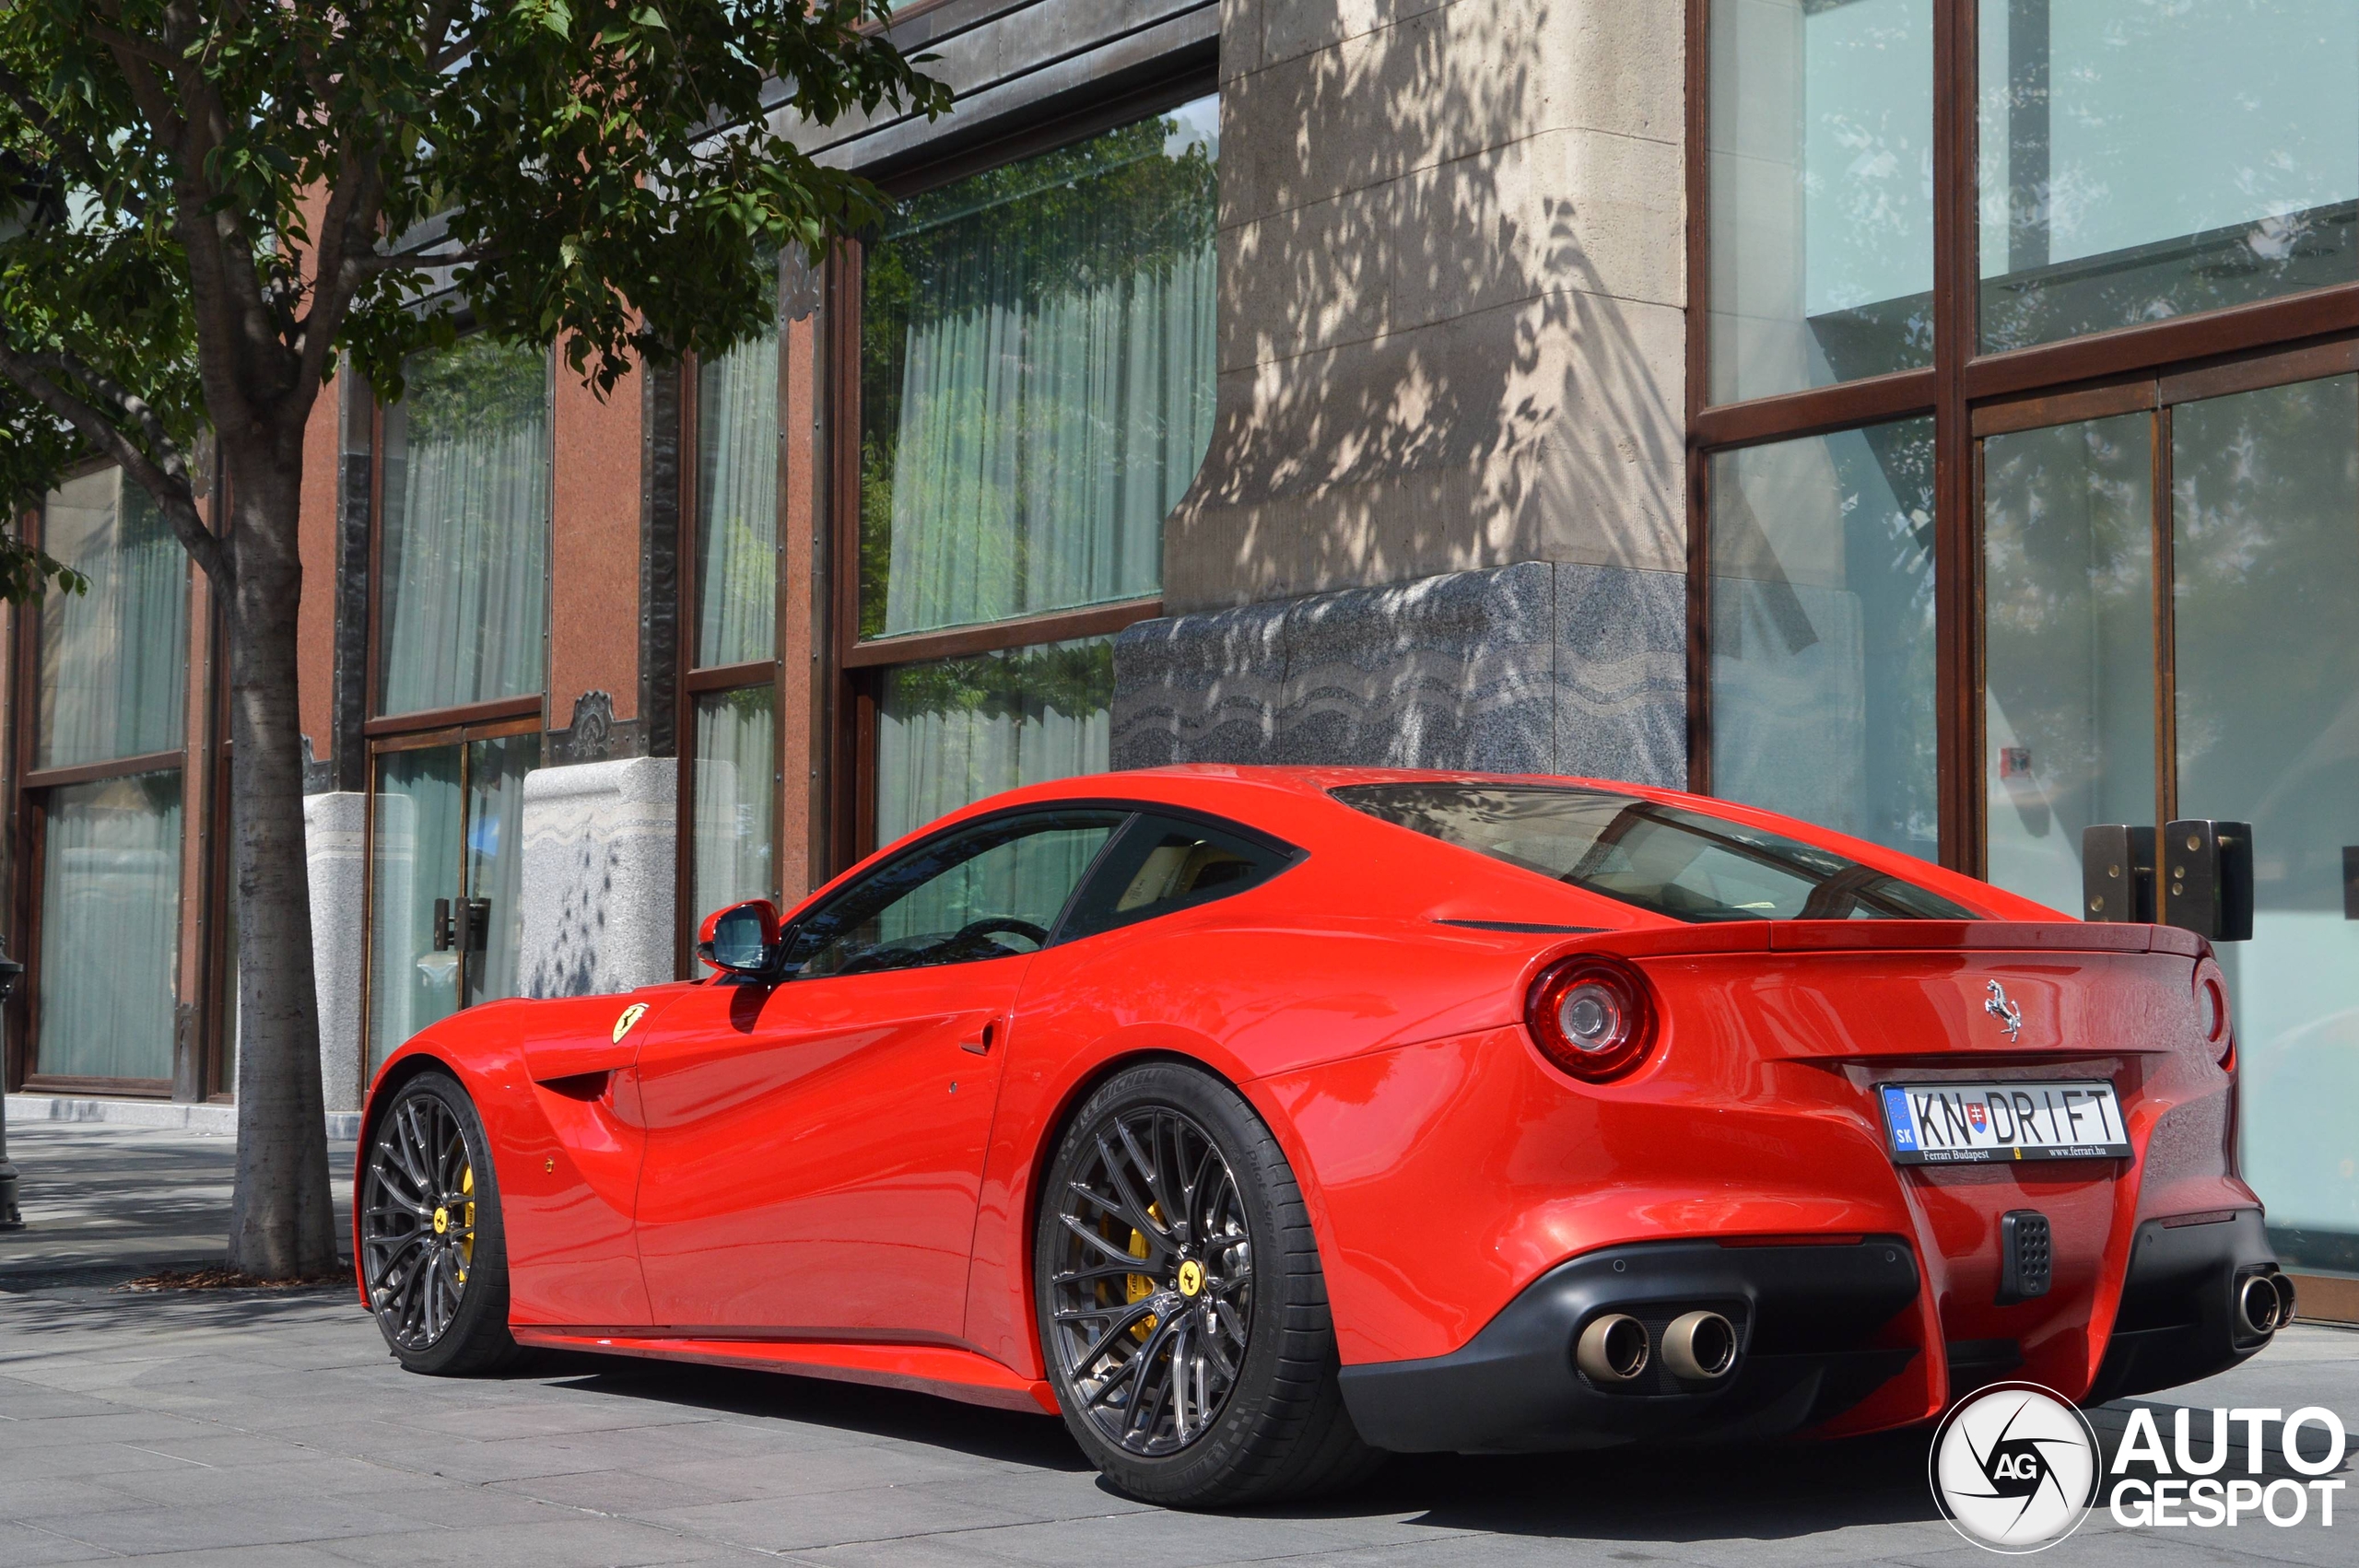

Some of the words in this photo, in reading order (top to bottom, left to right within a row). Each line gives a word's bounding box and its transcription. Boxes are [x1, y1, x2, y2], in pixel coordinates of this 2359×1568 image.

[1913, 1093, 1973, 1147] KN
[1985, 1090, 2112, 1144] DRIFT
[1896, 1129, 1913, 1143] SK
[1924, 1150, 1951, 1161] Ferrari
[1954, 1149, 1989, 1161] Budapest
[2048, 1146, 2107, 1157] www.ferrari.hu
